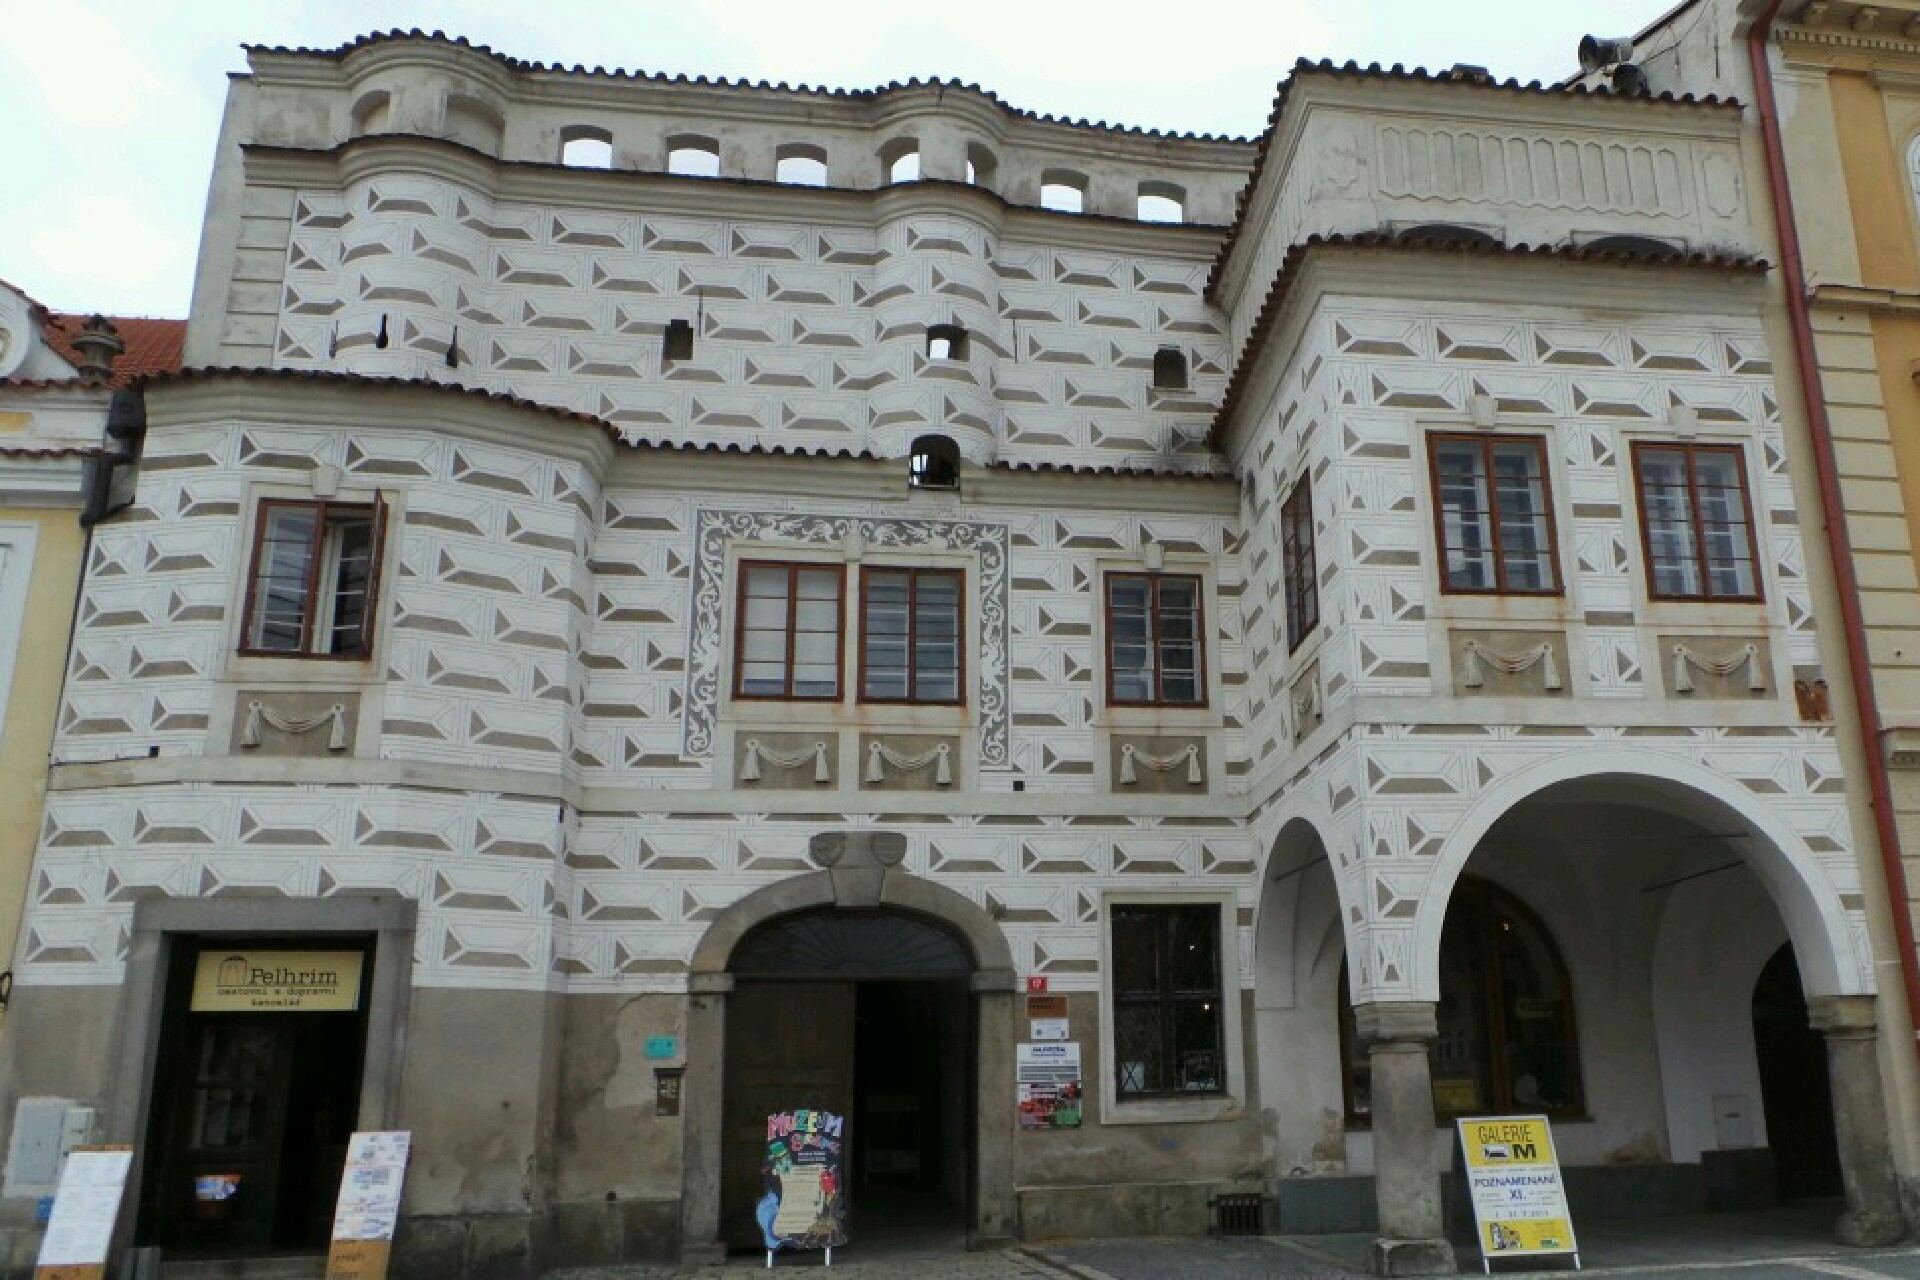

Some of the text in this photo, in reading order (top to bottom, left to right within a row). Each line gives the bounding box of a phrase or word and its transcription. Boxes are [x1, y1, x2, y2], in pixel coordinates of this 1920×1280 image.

[250, 968, 337, 985] Pelhrim
[767, 1110, 843, 1141] MUZEUM
[1478, 1124, 1533, 1144] GALERIE
[1512, 1144, 1537, 1159] M
